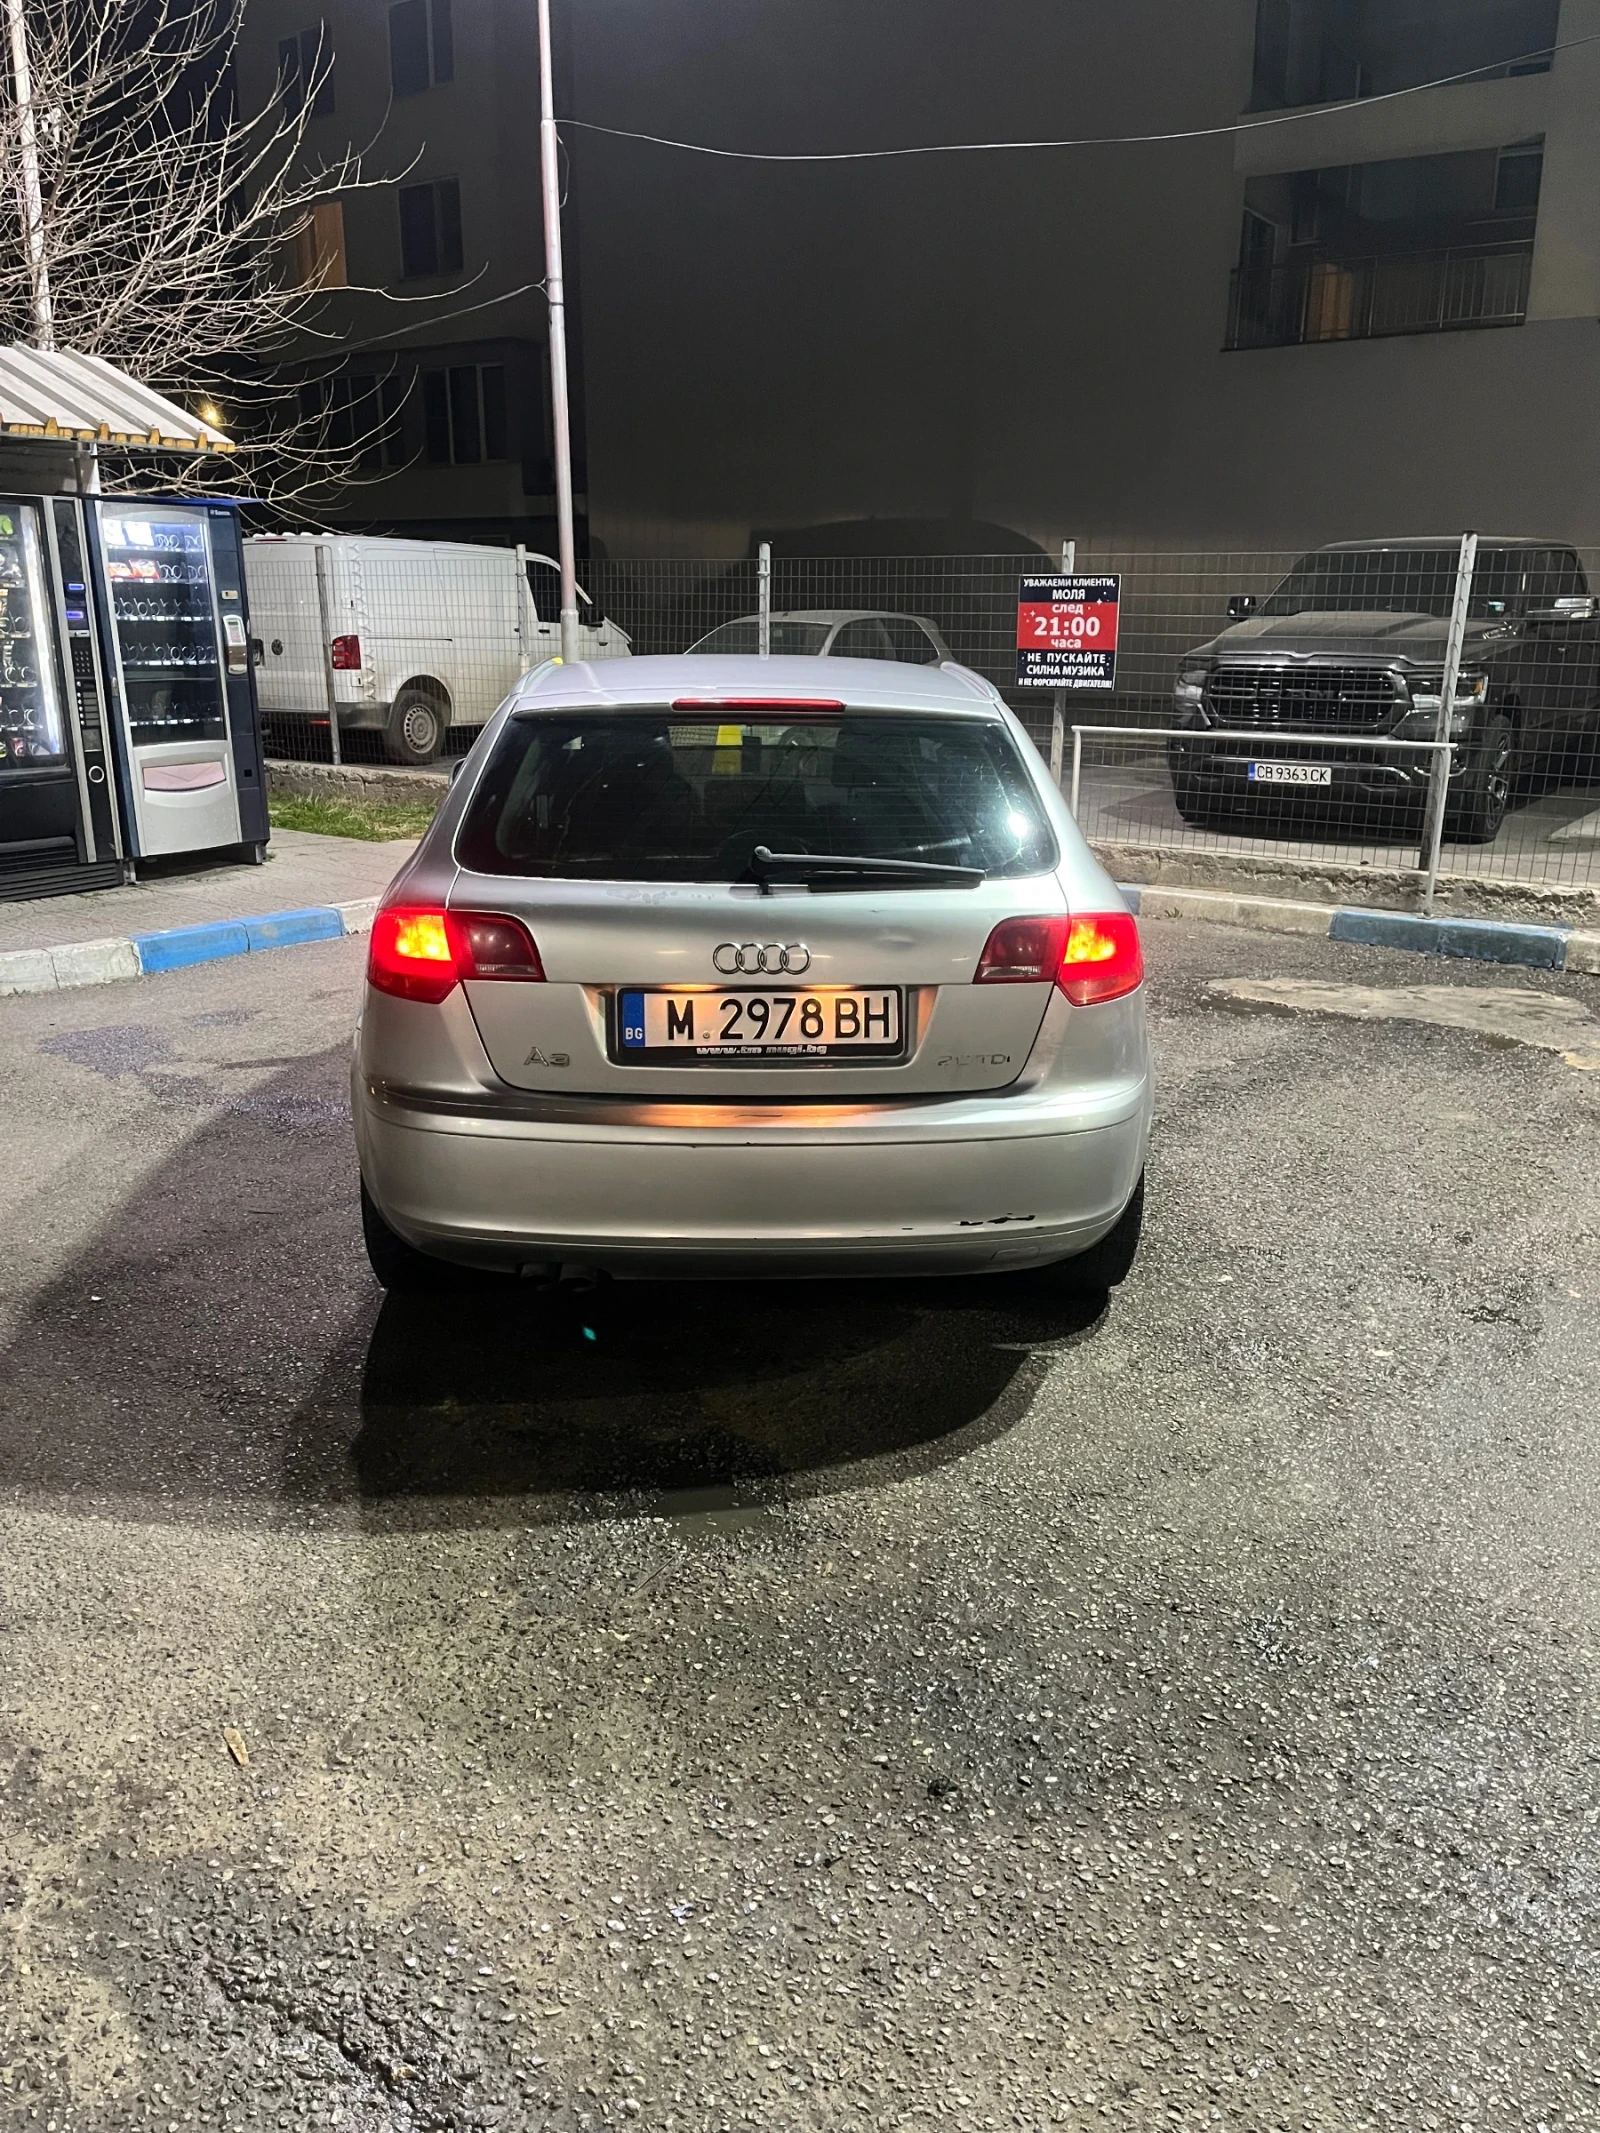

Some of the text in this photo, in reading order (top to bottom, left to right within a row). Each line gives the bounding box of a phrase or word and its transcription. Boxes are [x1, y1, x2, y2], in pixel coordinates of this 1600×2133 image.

[1023, 578, 1116, 587] УВАЖАЕМИ КЛИЕНТИ,
[1052, 589, 1085, 600] МОЛЯ
[1052, 603, 1084, 615] след
[1034, 616, 1100, 636] 21:00
[1051, 638, 1081, 648] часа
[1027, 652, 1106, 664] НЕ ПУСКАЙТЕ
[1026, 665, 1105, 676] СИЛНА МУЗИКА
[1018, 677, 1023, 686] И
[1024, 677, 1032, 686] НЕ
[1033, 677, 1073, 687] ФОРСИРАЙТЕ
[1257, 765, 1273, 779] CB
[1276, 767, 1308, 781] 9363
[1310, 768, 1328, 783] CK
[667, 999, 694, 1040] M
[719, 998, 824, 1040] 2978
[625, 1027, 643, 1040] BG
[523, 1046, 570, 1068] A3
